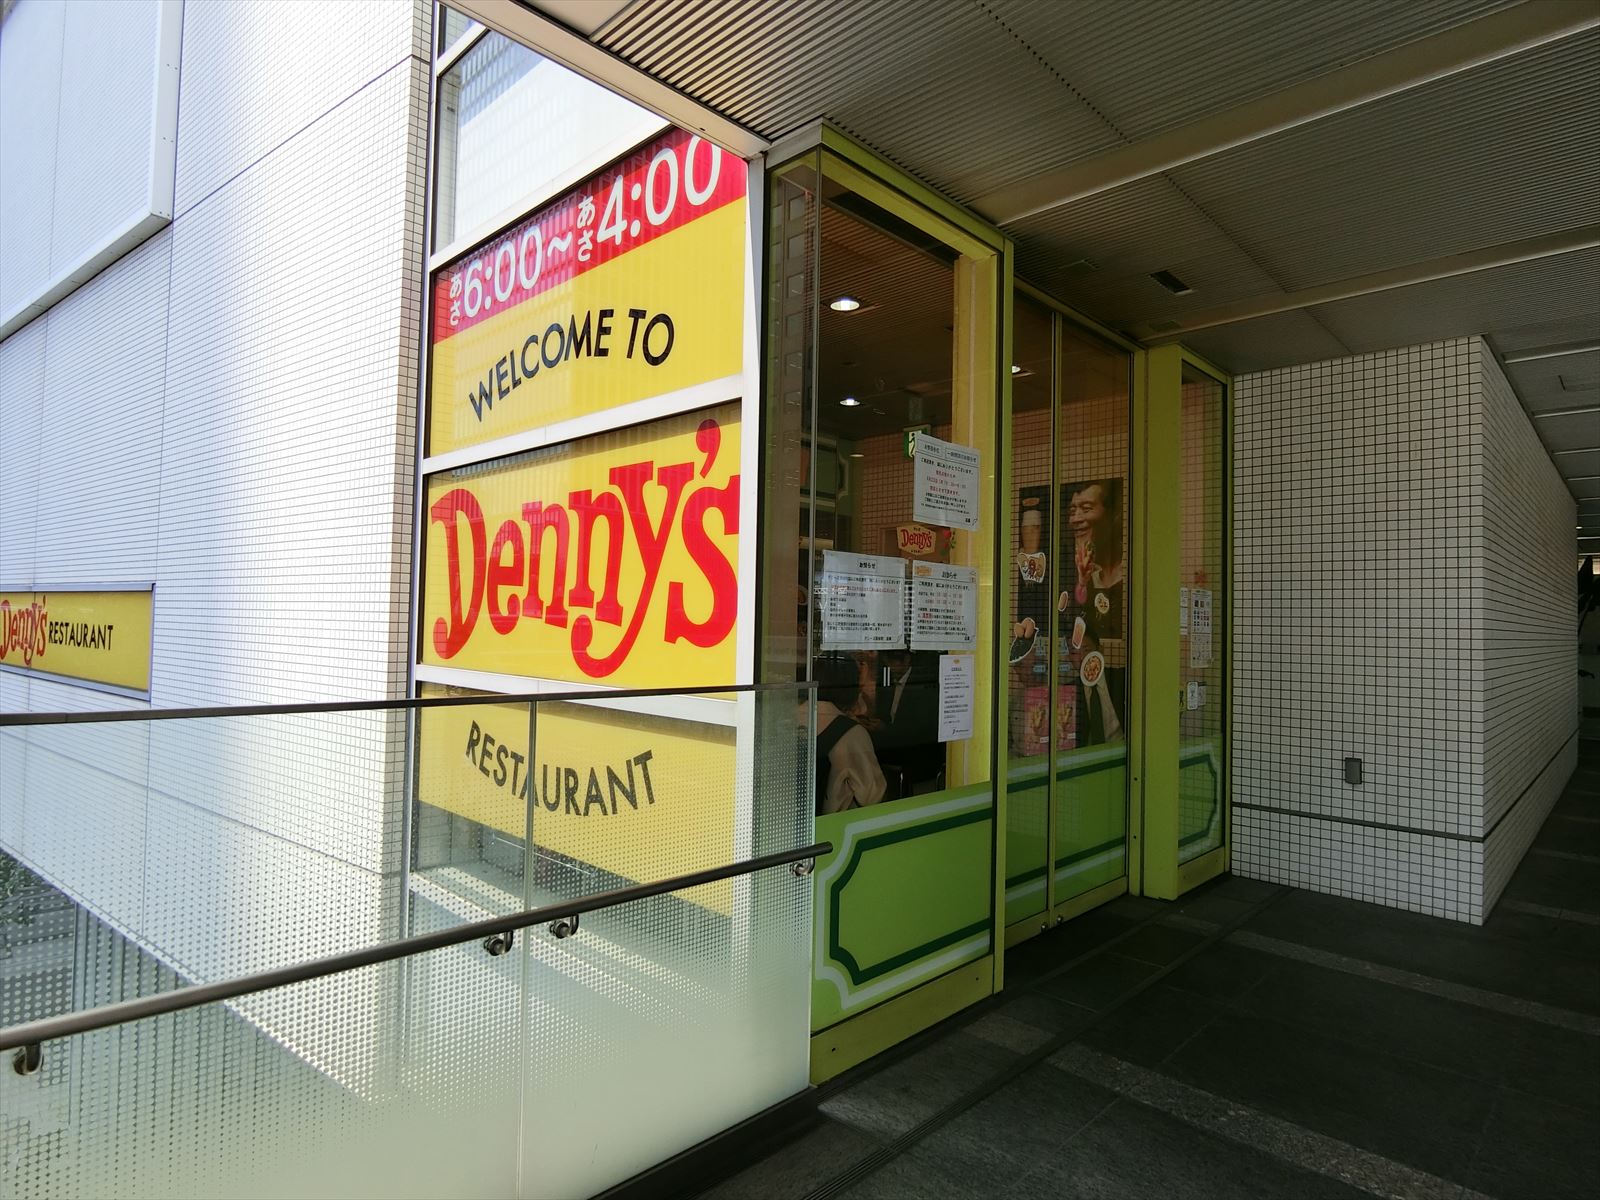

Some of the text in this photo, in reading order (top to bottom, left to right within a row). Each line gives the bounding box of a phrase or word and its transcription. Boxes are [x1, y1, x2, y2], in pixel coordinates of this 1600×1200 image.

[450, 271, 462, 326] あさ
[577, 195, 596, 263] あさ
[597, 135, 721, 247] 4:00
[468, 309, 675, 423] WELCOME TO
[430, 418, 741, 678] Denny's
[901, 528, 932, 549] Denny's
[0, 595, 113, 666] Denny's RESTAURANT
[465, 720, 654, 816] RESTAURANT
